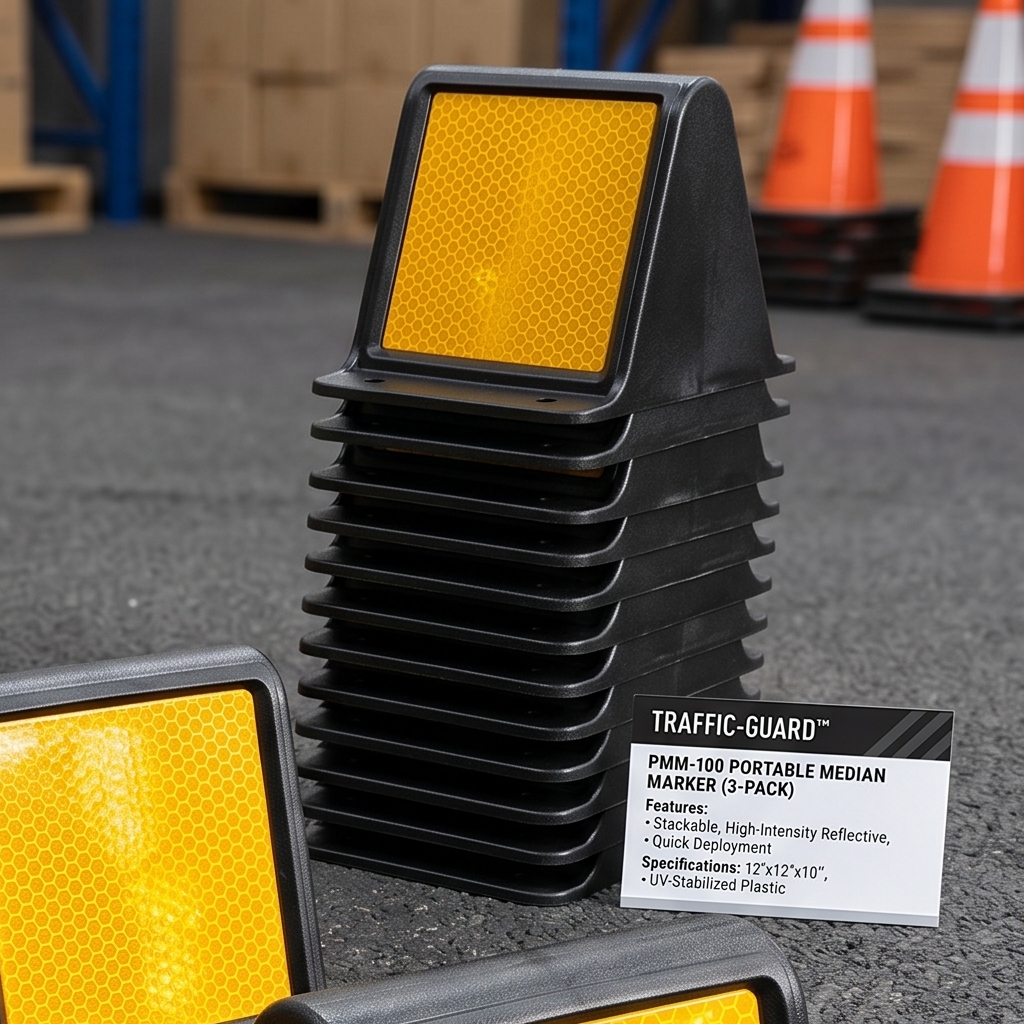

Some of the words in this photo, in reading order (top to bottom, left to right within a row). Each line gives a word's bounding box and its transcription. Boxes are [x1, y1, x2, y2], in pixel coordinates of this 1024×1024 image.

[648, 754, 724, 774] PMM-100
[729, 759, 815, 780] PORTABLE
[819, 764, 886, 783] MEDIAN
[647, 774, 716, 793] MARKER
[721, 777, 795, 800] (3-PACK)
[645, 798, 708, 815] Features:
[653, 817, 721, 836] Stackable,
[725, 821, 818, 843] High-Intensity
[821, 827, 891, 846] Reflective,
[652, 834, 690, 850] Quick
[693, 836, 772, 856] Deployment
[641, 855, 741, 875] Specifications:
[649, 873, 737, 892] UV-Stabilized
[740, 879, 786, 895] Plastic
